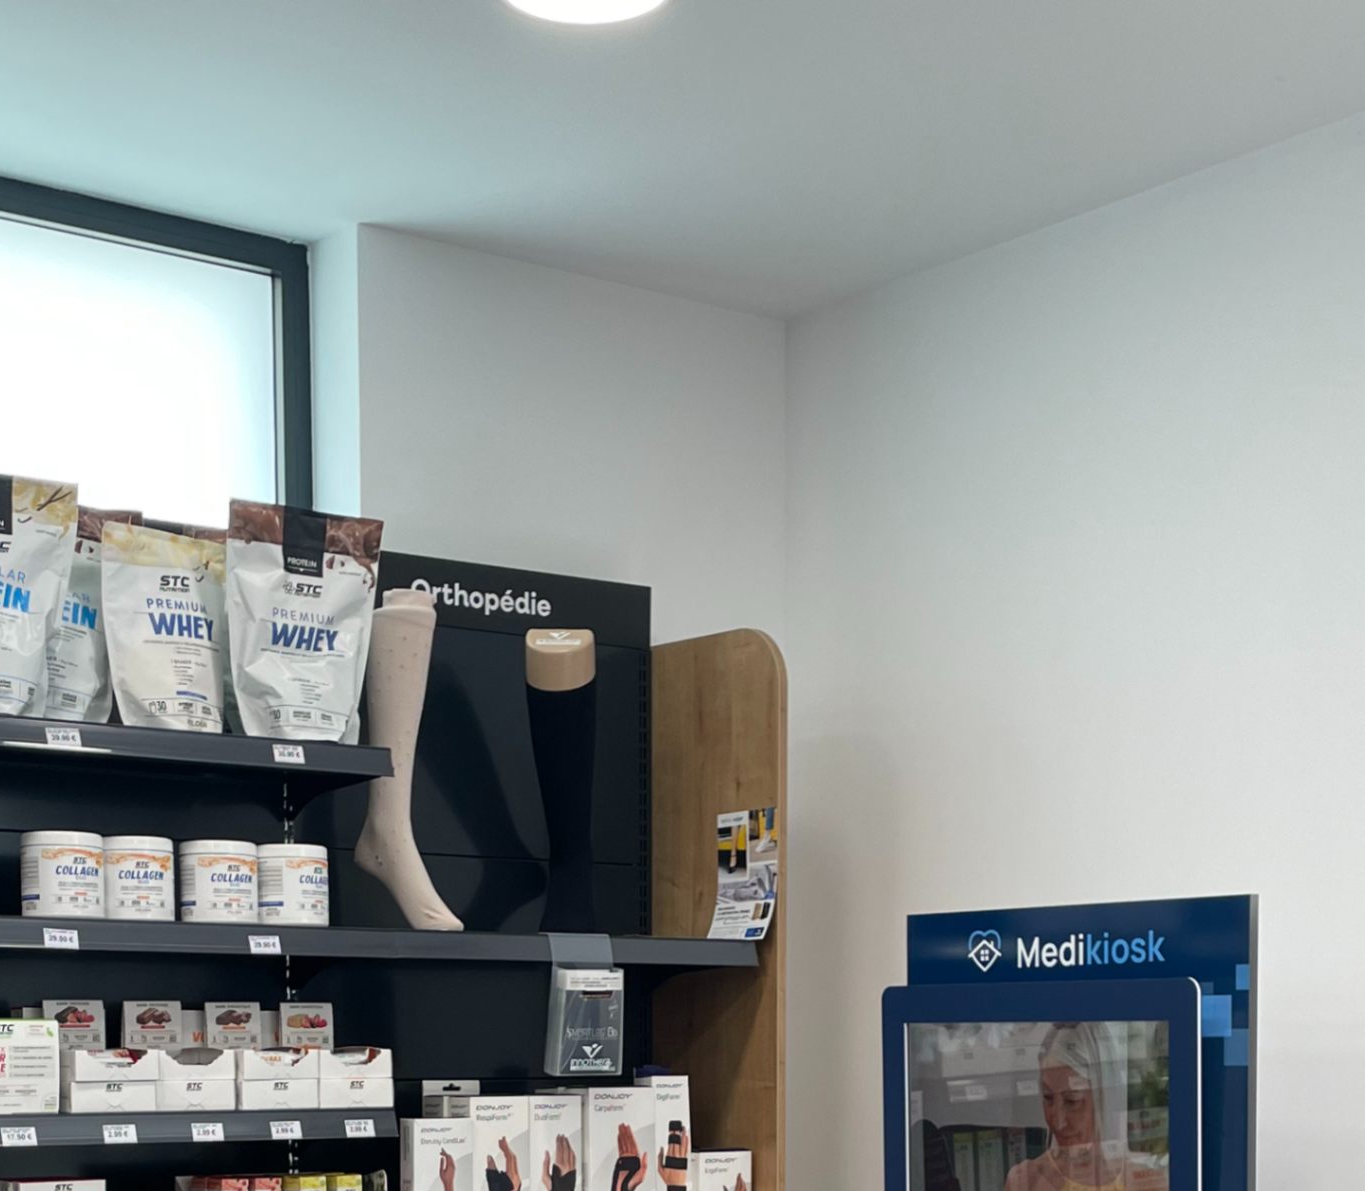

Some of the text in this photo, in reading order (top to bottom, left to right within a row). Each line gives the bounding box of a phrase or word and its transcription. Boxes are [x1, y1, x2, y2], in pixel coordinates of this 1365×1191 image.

[288, 557, 316, 567] PROTEIN
[160, 576, 190, 587] STC
[296, 583, 322, 595] STC
[146, 598, 206, 613] PREMIUM
[273, 607, 334, 625] PREMIUM
[148, 613, 213, 641] WHEY
[271, 622, 338, 651] WHEY
[56, 865, 99, 877] COLLAGEN
[119, 870, 164, 881] COLLAGEN
[1017, 930, 1166, 969] Medikiosk
